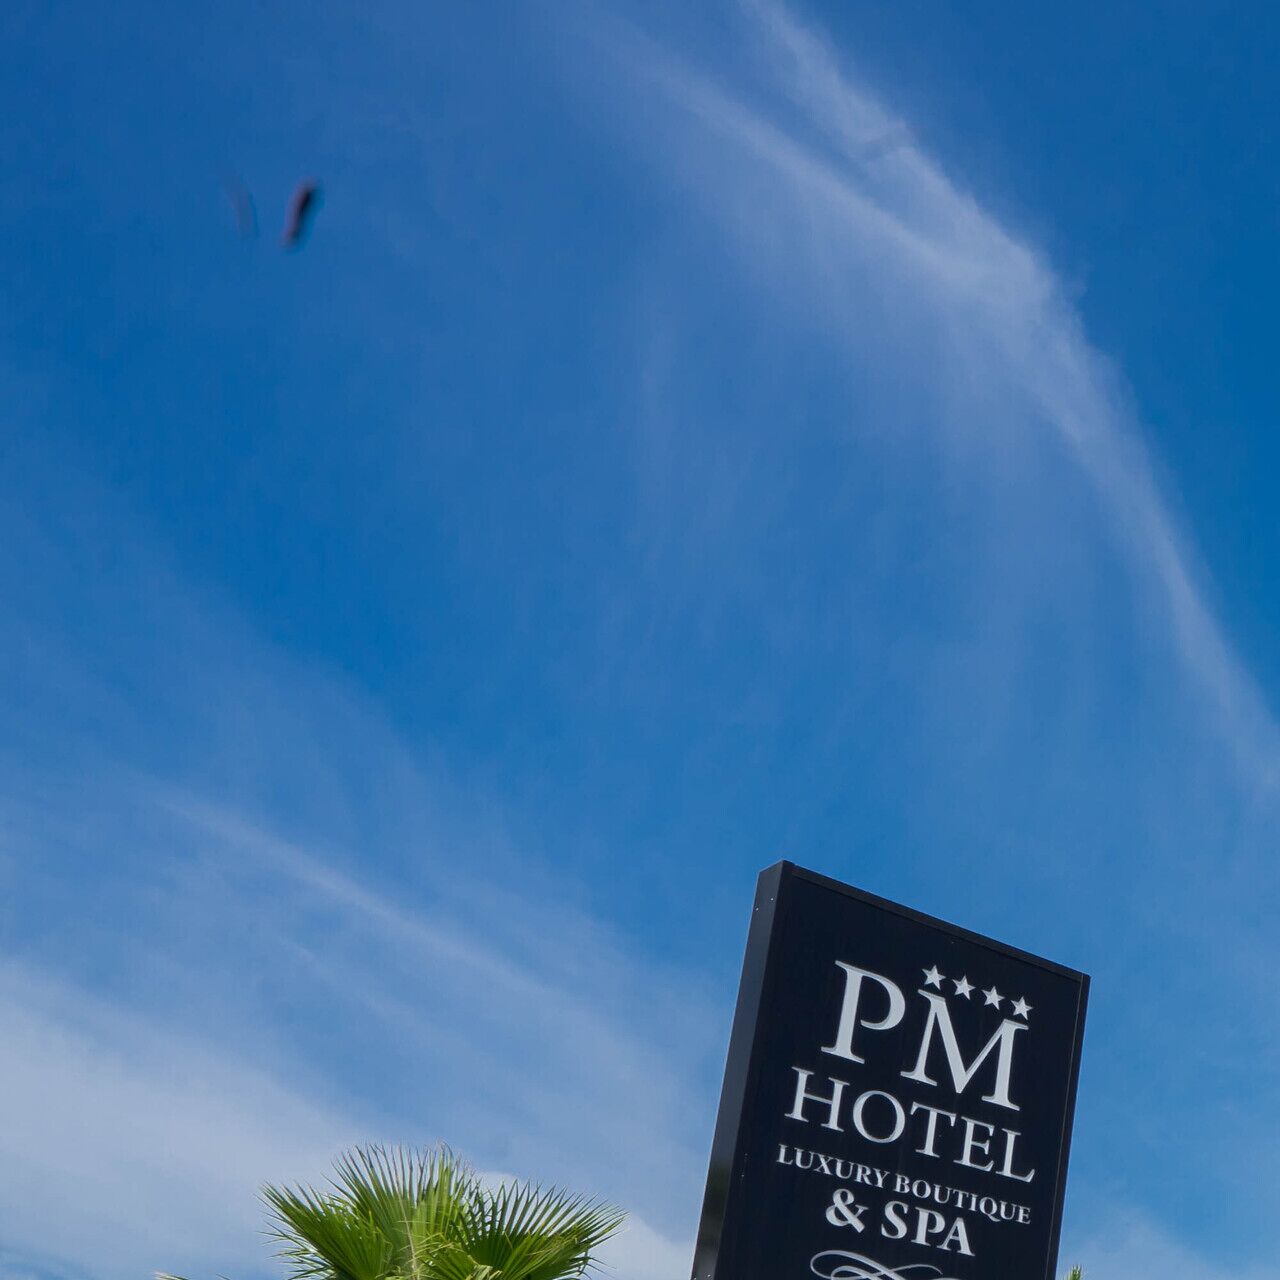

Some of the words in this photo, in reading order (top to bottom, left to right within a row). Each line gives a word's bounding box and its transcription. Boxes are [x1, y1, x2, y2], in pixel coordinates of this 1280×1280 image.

[821, 960, 1029, 1112] PM
[784, 1066, 1035, 1183] HOTEL
[776, 1144, 890, 1189] LUXURY
[893, 1173, 1032, 1225] BOUTIQUE
[825, 1188, 869, 1233] &
[881, 1200, 975, 1257] SPA
